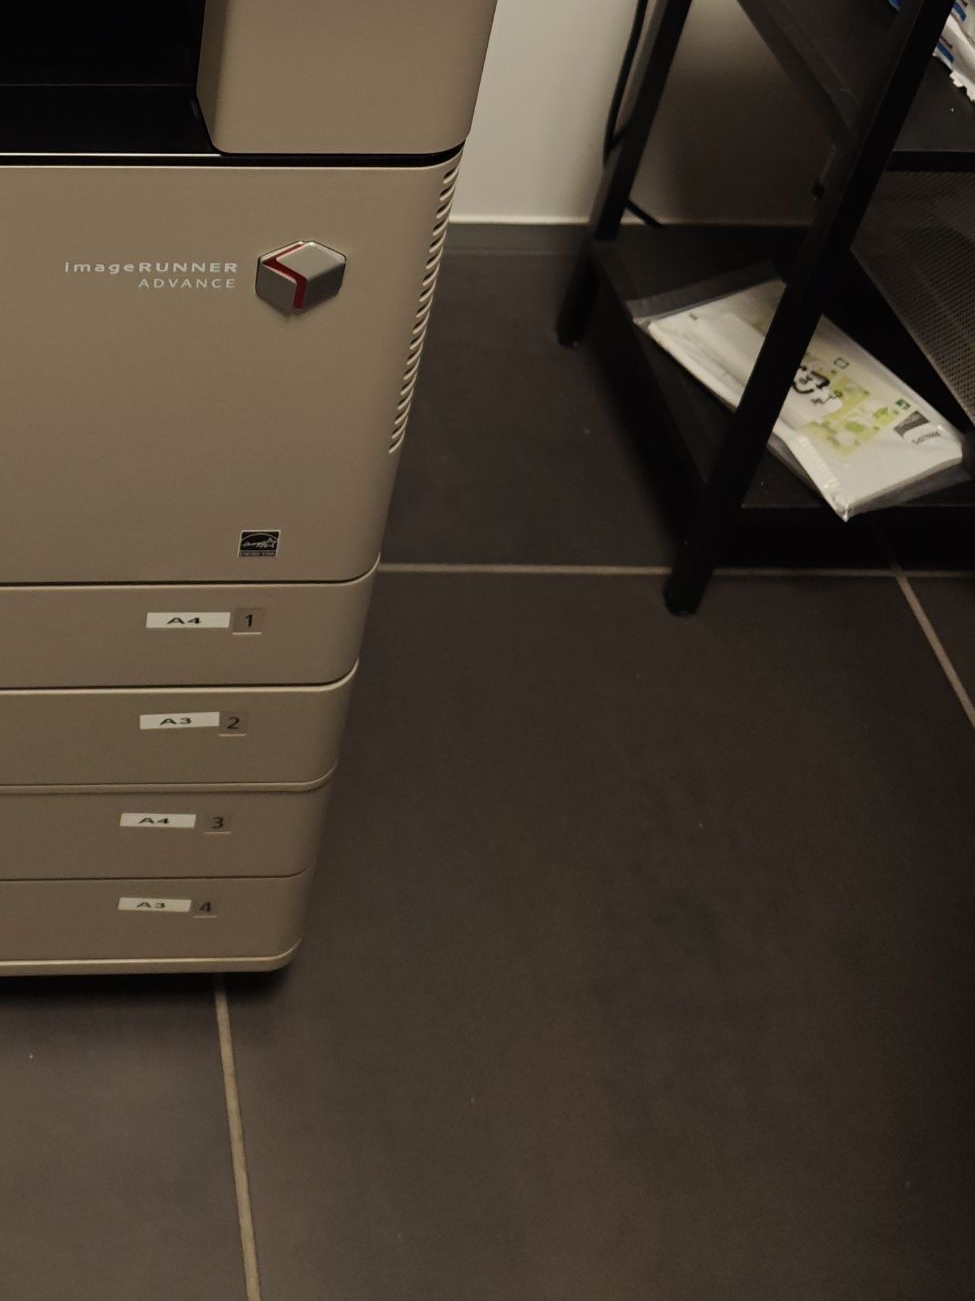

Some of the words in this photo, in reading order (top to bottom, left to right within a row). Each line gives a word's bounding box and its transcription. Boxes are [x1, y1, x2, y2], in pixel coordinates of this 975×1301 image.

[64, 261, 238, 275] imageRUNNER
[138, 278, 237, 289] ADVANCE
[166, 617, 202, 625] A4
[245, 614, 254, 628] 1
[159, 716, 192, 725] A3
[226, 716, 240, 729] 2
[138, 817, 171, 825] A4
[212, 816, 224, 829] 3
[136, 901, 166, 909] A3
[199, 901, 212, 912] 4
